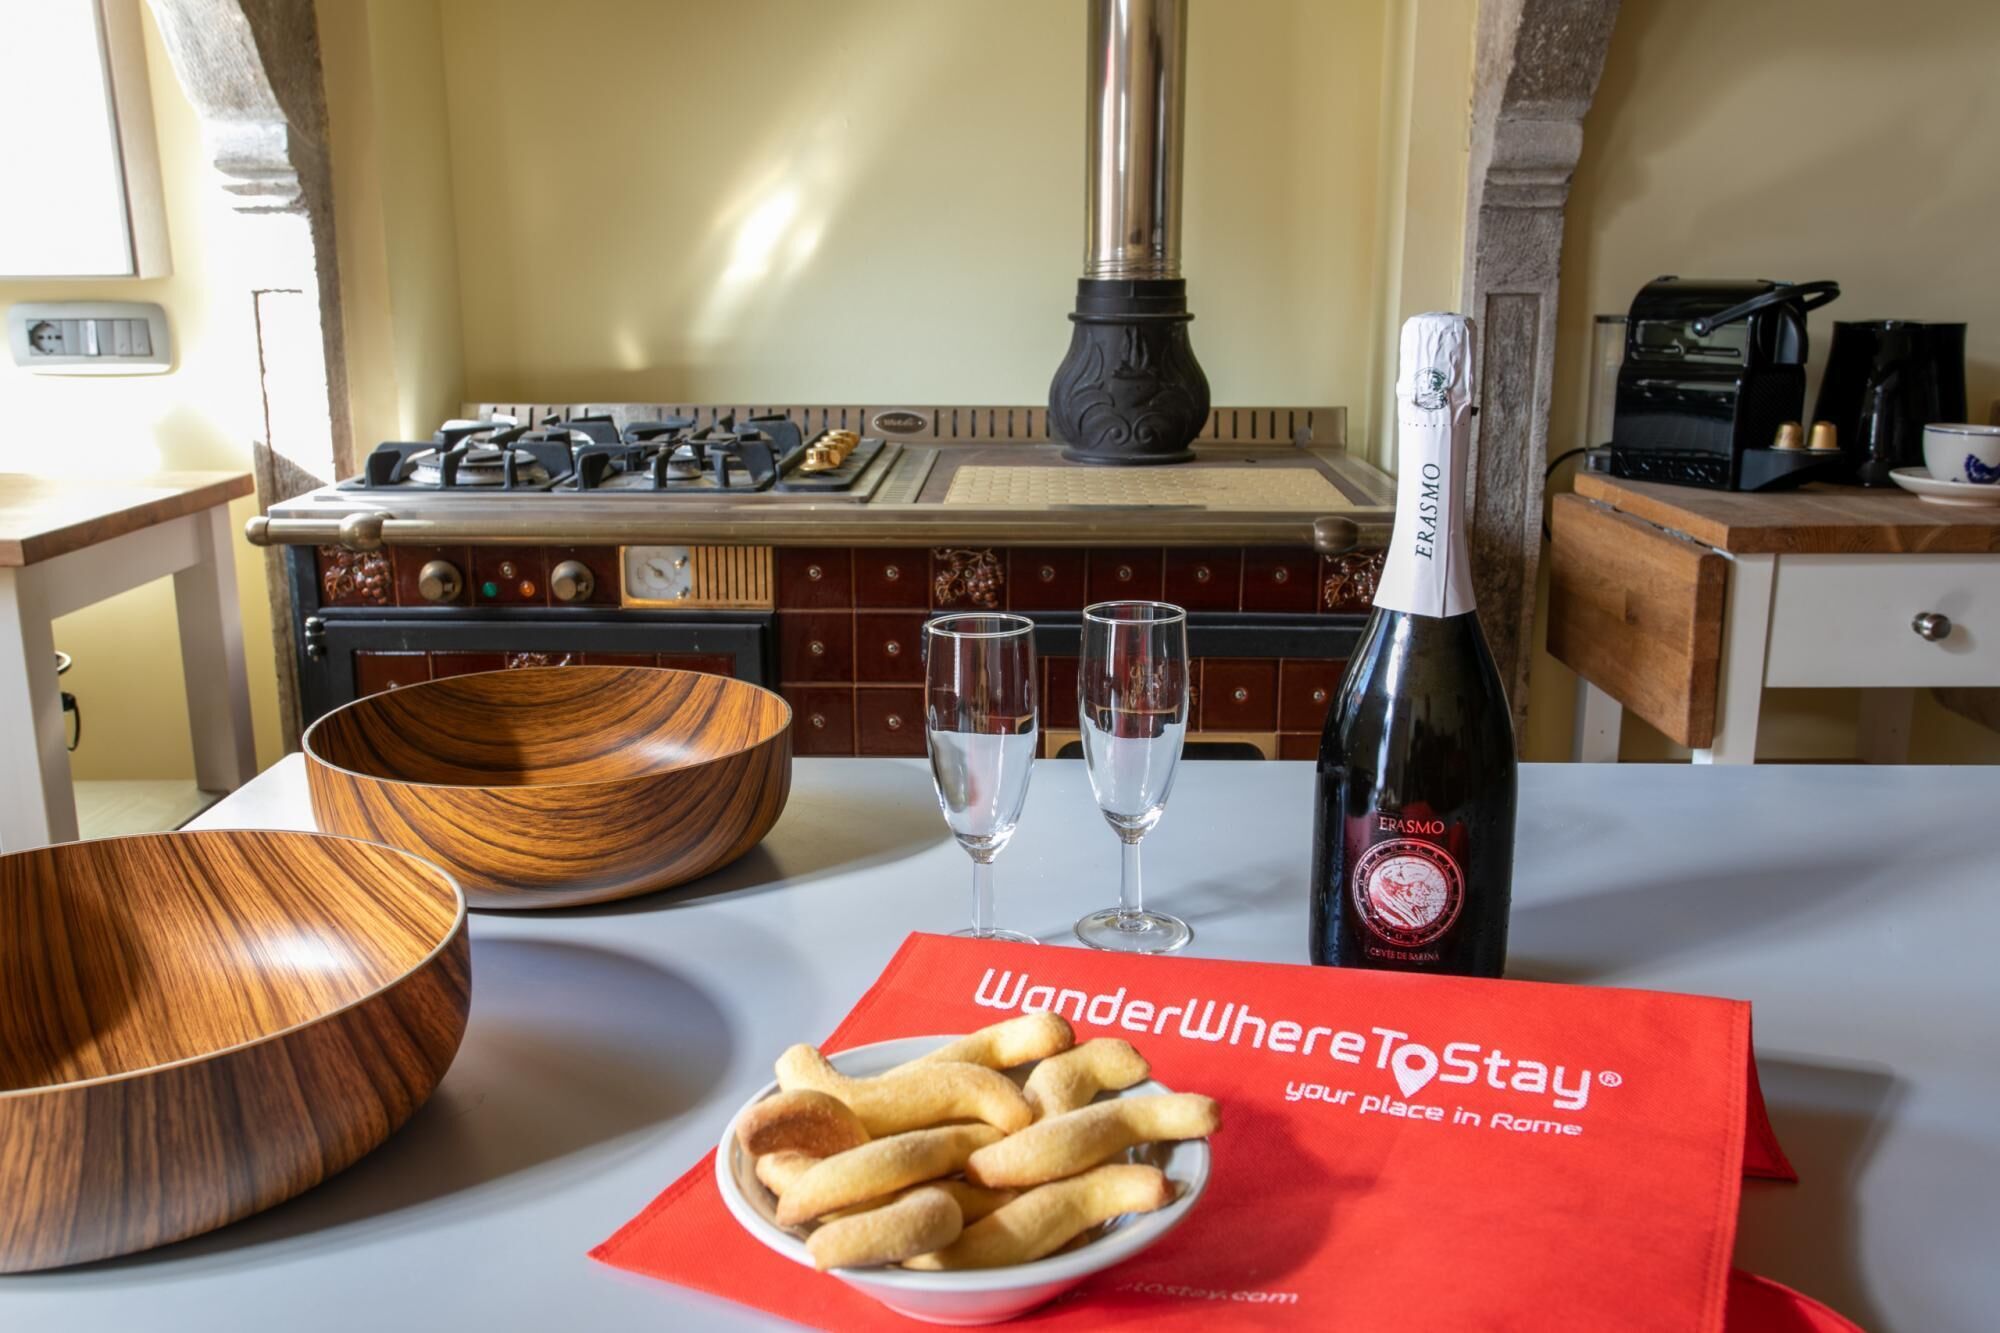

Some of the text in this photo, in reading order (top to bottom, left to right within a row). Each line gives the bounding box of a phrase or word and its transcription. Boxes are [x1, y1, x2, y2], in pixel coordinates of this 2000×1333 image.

[1415, 462, 1441, 561] ERASMO
[1378, 816, 1446, 835] ERASMO
[1285, 1080, 1584, 1136] your place in Rome
